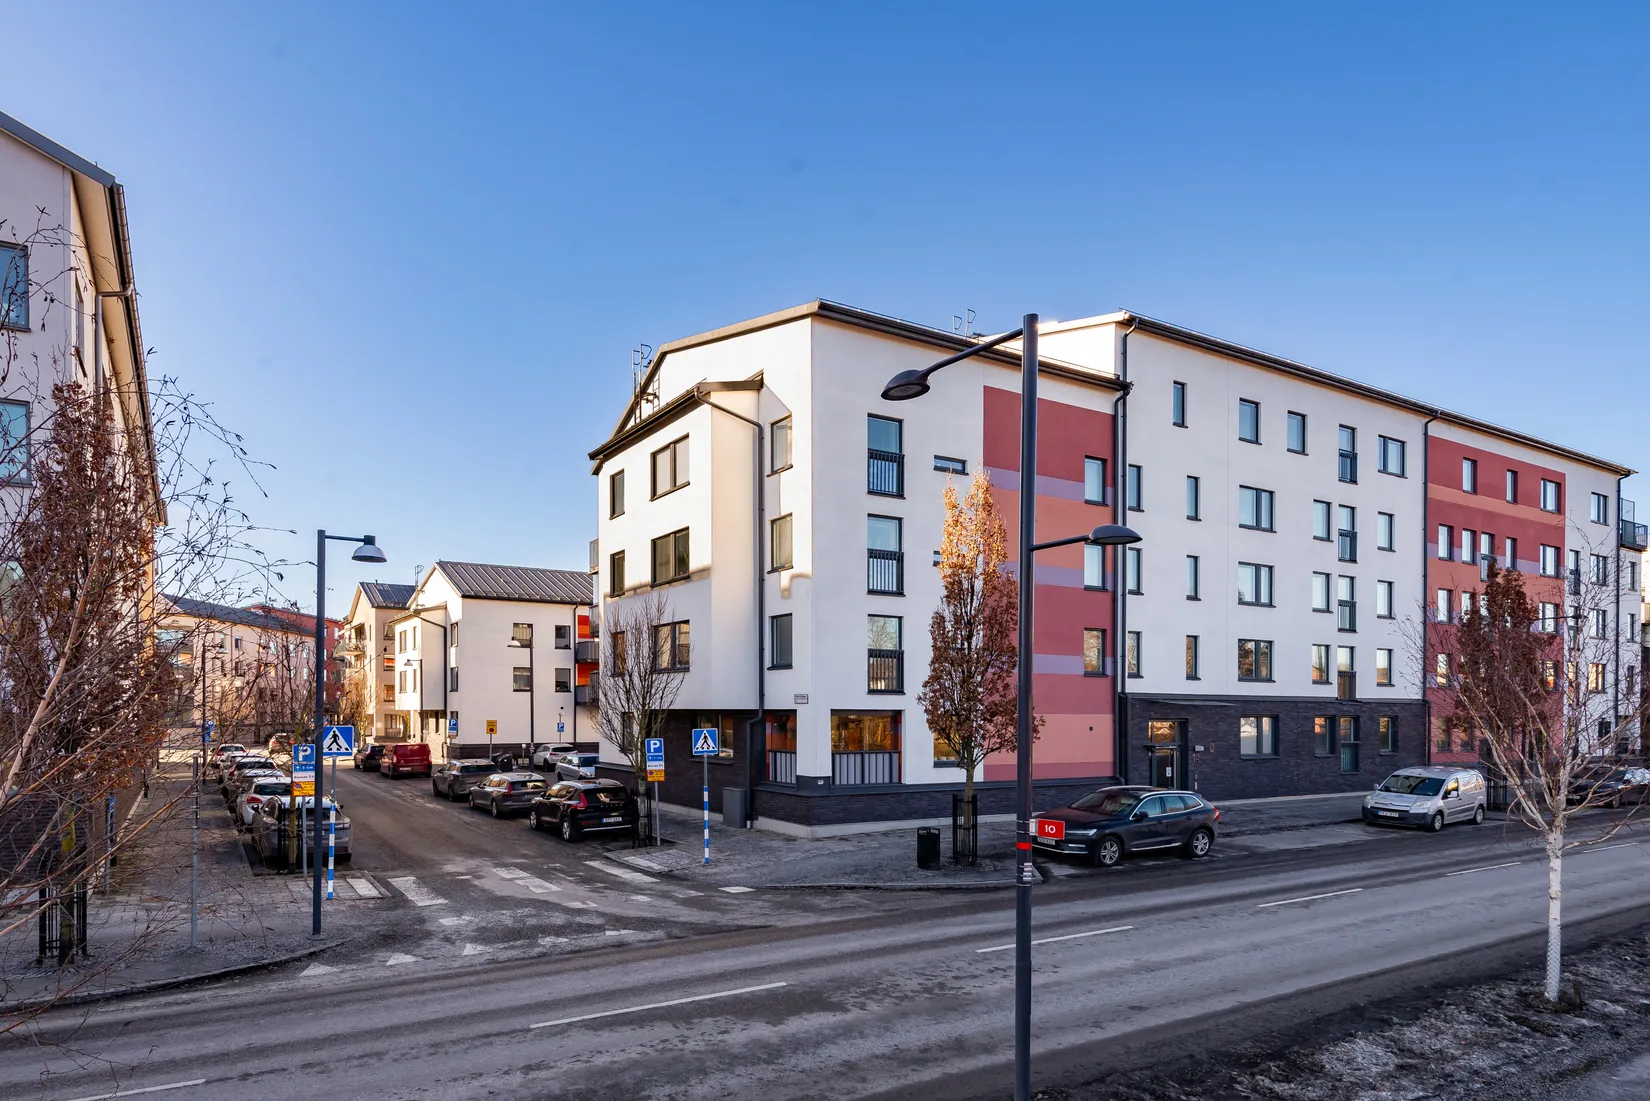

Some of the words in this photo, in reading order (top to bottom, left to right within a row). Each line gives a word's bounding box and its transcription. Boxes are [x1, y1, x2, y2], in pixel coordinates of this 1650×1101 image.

[650, 740, 660, 752] P
[298, 746, 311, 761] P
[1044, 824, 1056, 834] 10
